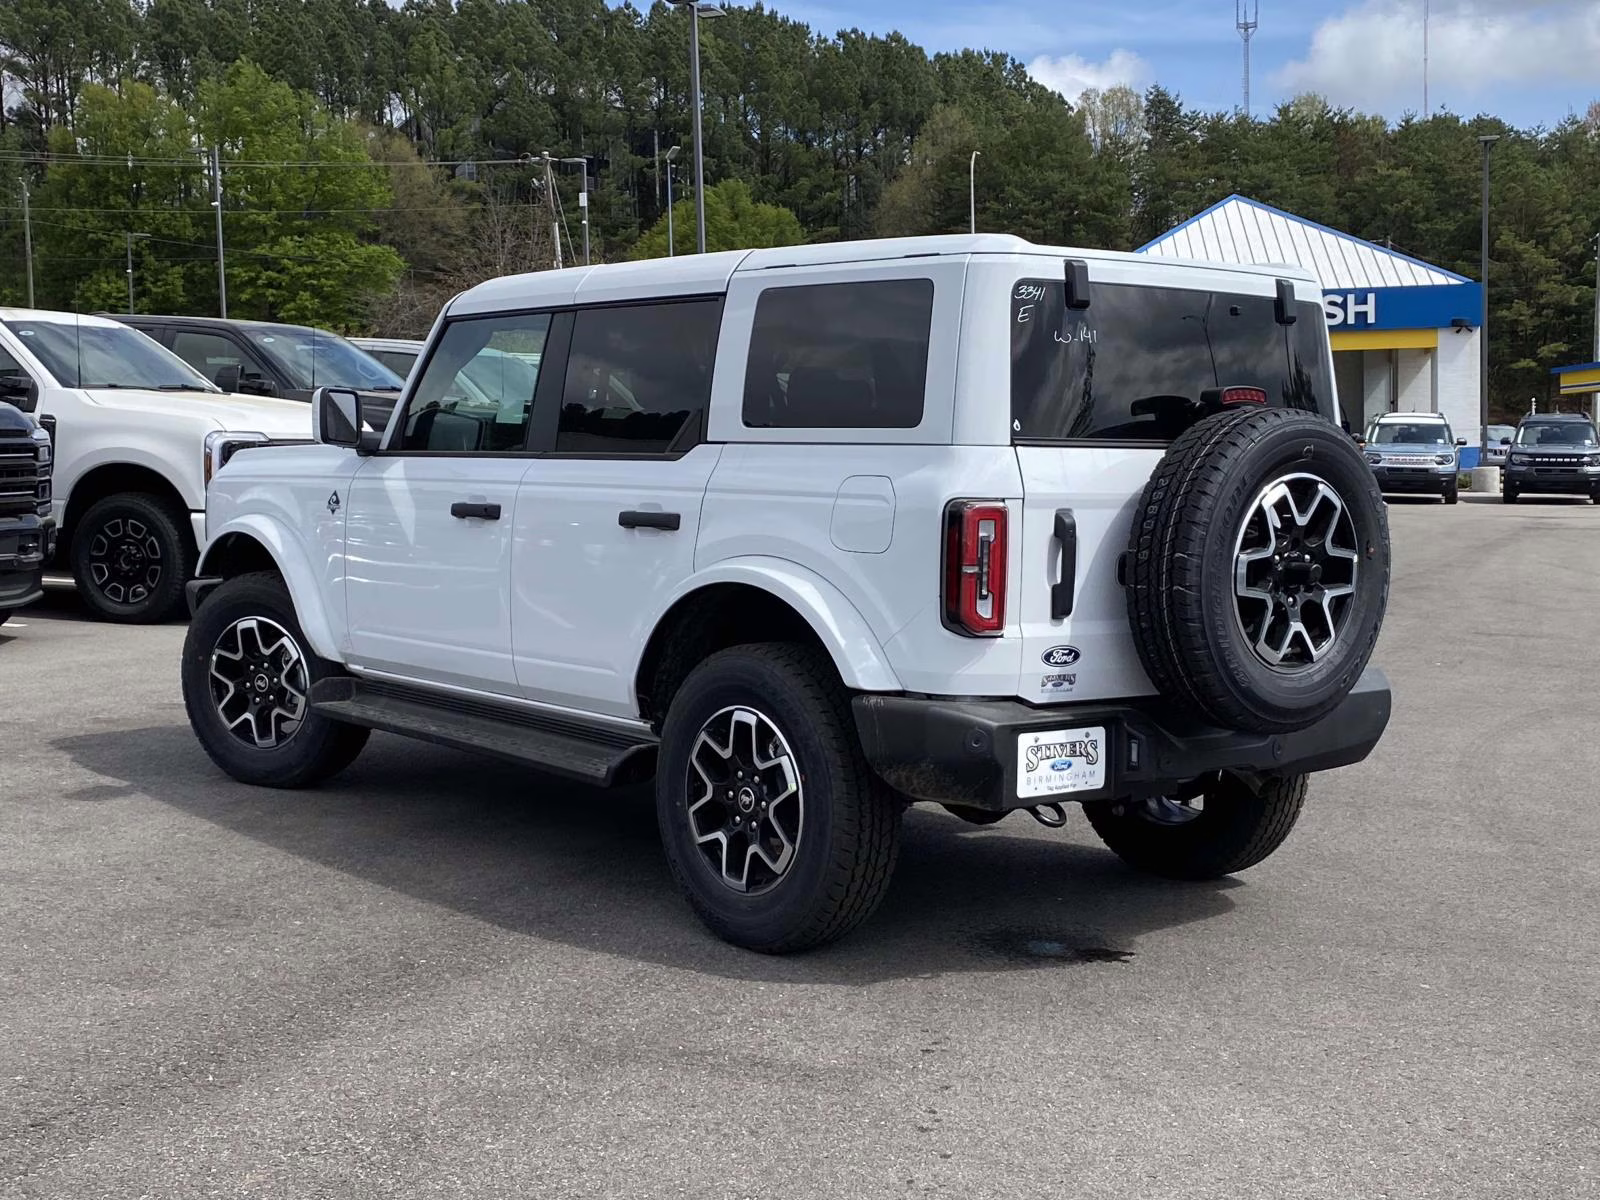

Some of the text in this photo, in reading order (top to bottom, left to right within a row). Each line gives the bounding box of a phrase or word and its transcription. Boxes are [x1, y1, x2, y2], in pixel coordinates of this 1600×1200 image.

[1014, 285, 1046, 301] 3341
[1017, 304, 1034, 323] E
[1049, 649, 1075, 663] Ford
[1026, 739, 1099, 773] STIVERS
[1026, 770, 1096, 786] BIRMINGHAM
